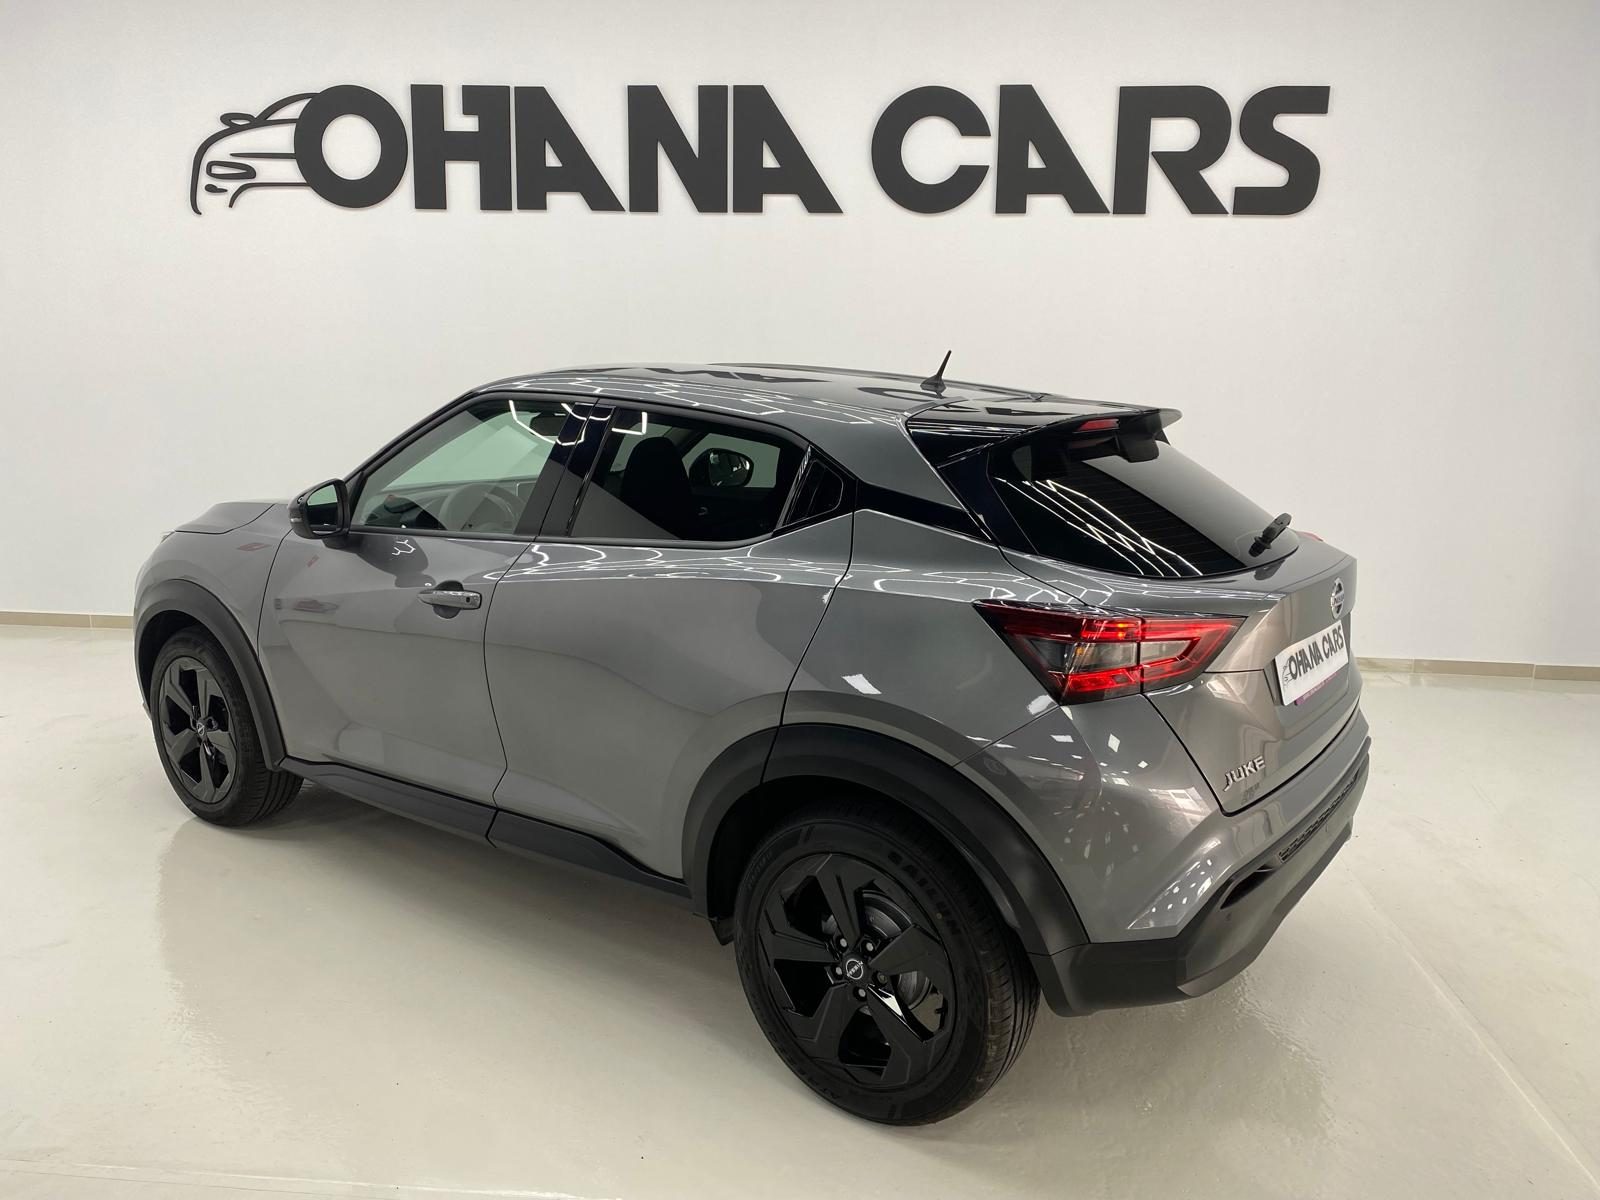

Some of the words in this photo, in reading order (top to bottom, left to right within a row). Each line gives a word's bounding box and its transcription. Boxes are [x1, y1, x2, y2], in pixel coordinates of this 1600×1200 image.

[293, 84, 844, 213] OHANA
[871, 84, 1331, 215] CARS
[1288, 641, 1324, 680] OHANA
[1322, 624, 1344, 659] CARS
[1222, 755, 1266, 792] JUKE
